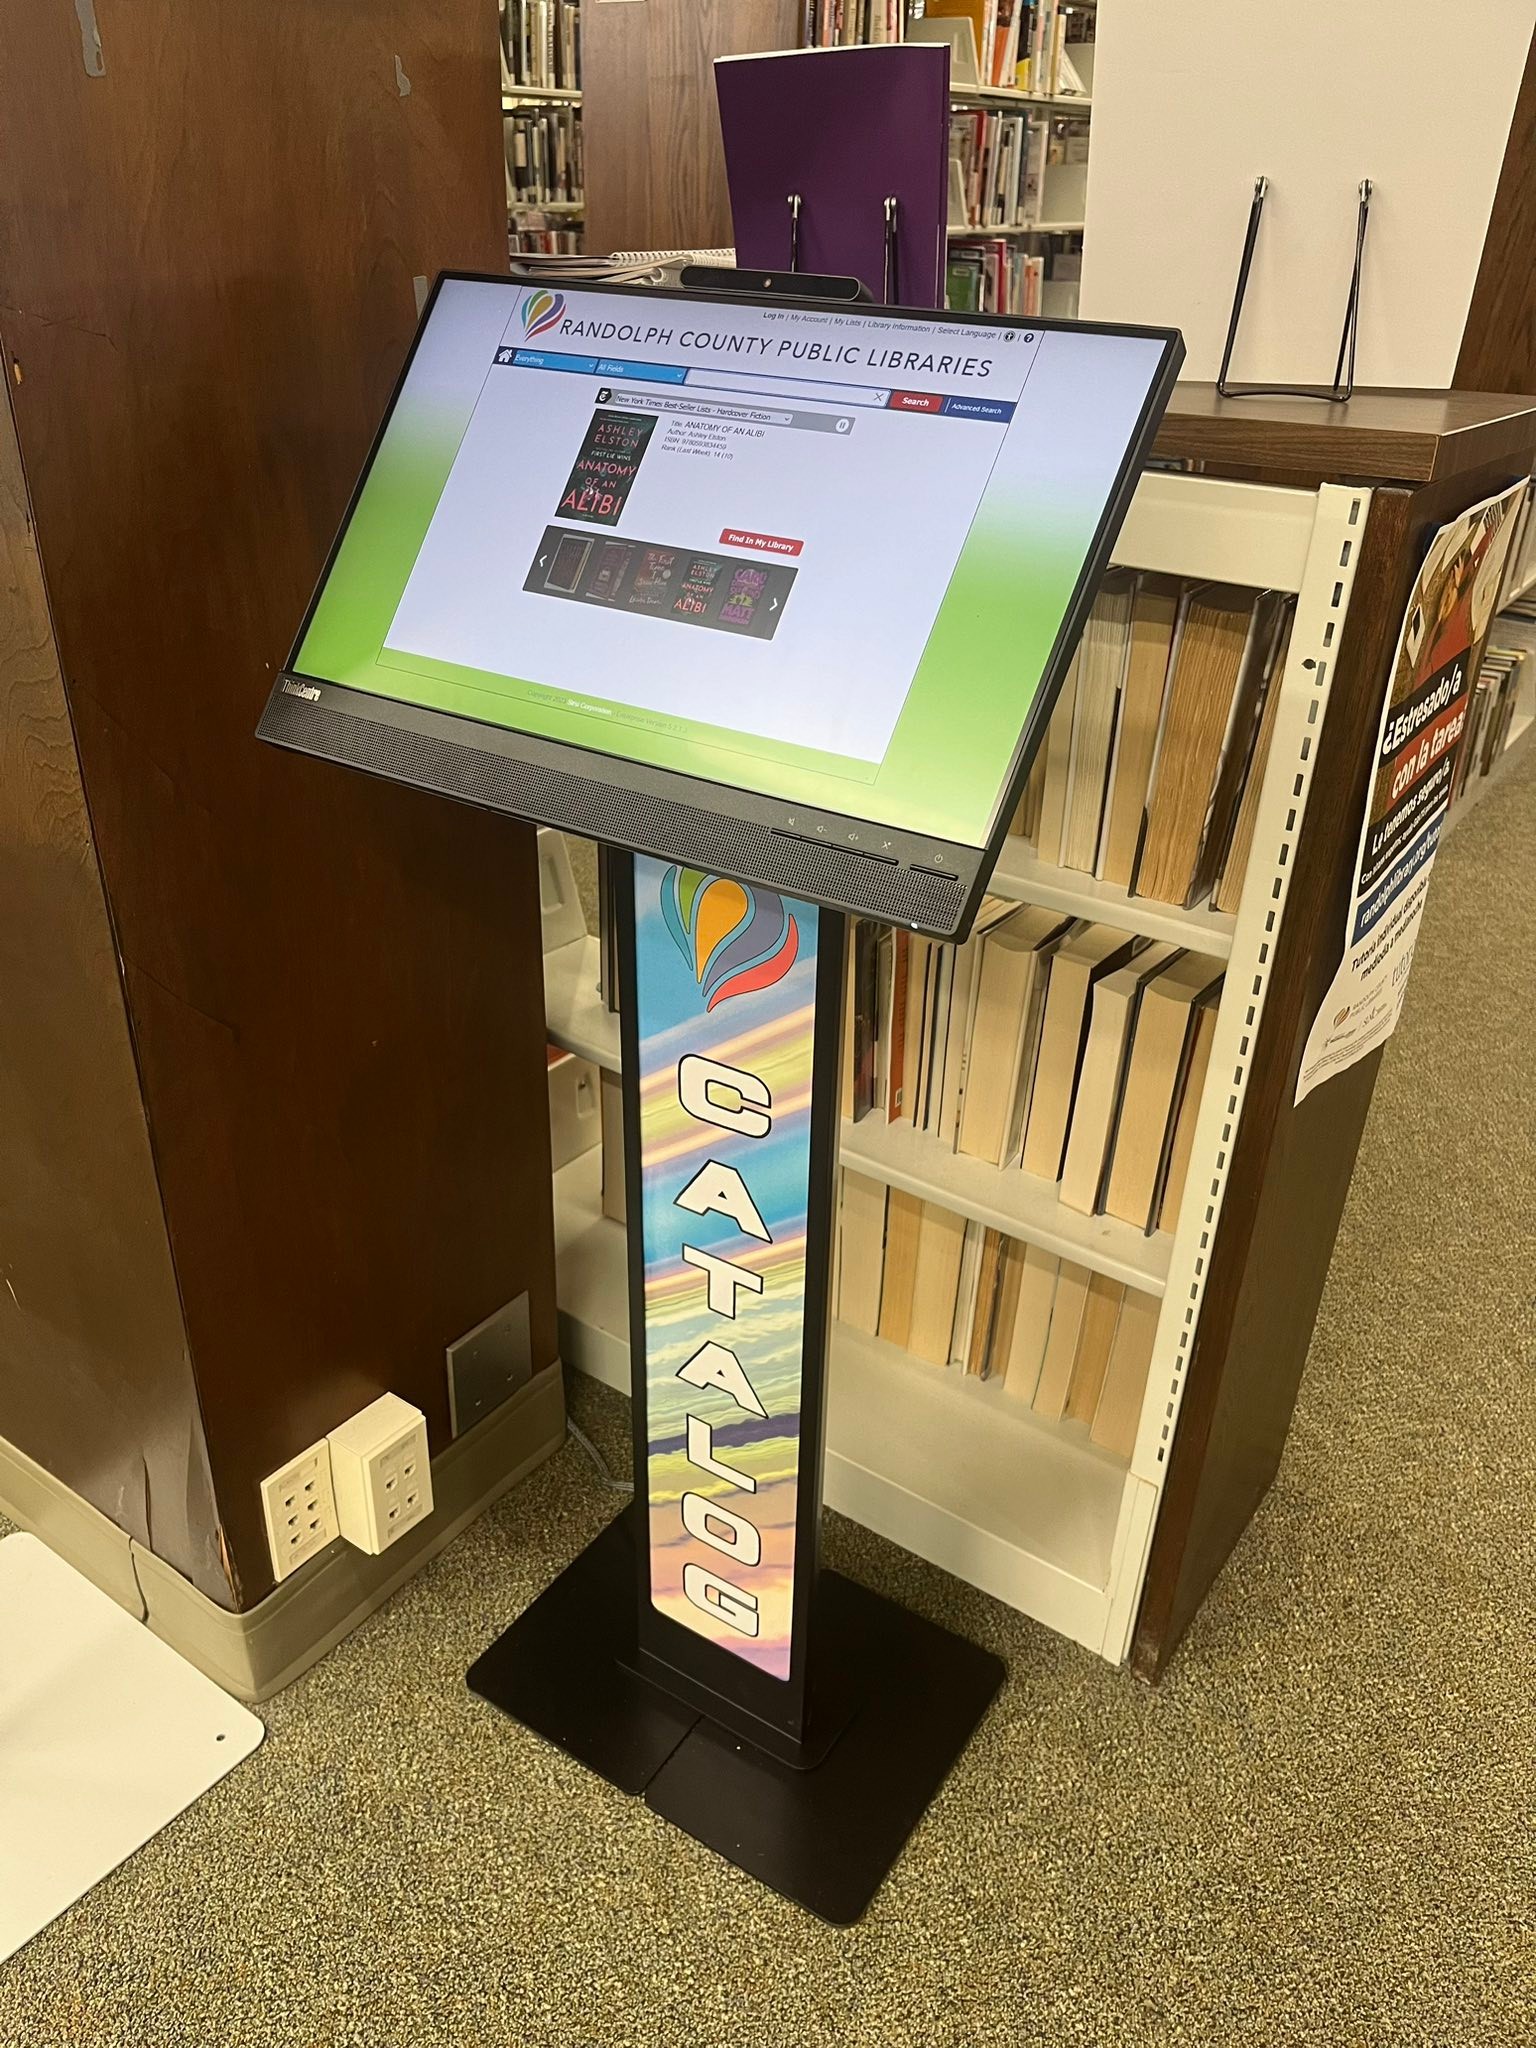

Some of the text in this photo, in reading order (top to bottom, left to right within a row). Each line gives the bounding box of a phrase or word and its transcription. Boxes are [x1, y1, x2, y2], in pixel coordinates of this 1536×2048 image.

[763, 311, 777, 320] Log
[791, 314, 828, 325] My Account
[834, 318, 861, 327] My Lists
[868, 321, 931, 334] Library Information
[938, 326, 996, 340] Select Language
[559, 318, 993, 378] RANDOLPH COUNTY PUBLIC LIBRARIES
[514, 353, 545, 365] Everything
[598, 363, 624, 373] All Fields
[616, 395, 630, 404] New
[630, 396, 645, 405] York
[646, 398, 663, 407] Times
[664, 400, 696, 411] Best-Seller
[697, 404, 711, 414] Lists
[717, 408, 749, 418] Hardcover
[750, 411, 771, 421] Fiction
[902, 396, 930, 408] Search
[951, 402, 1002, 415] Advanced Search
[598, 424, 643, 437] ASHLEY
[684, 421, 721, 432] ANATOMY
[722, 425, 733, 433] OF
[733, 427, 747, 435] AN
[747, 428, 765, 438] ALIBI
[595, 434, 639, 448] ELSTON
[577, 459, 637, 477] ANATOMY
[585, 477, 617, 488] OF AN
[561, 489, 622, 516] ALIBI
[728, 533, 794, 553] Find In My Library
[673, 598, 707, 614] ALIBI
[1382, 663, 1462, 755] ¿Estresado/a
[1392, 754, 1416, 799] con
[1416, 738, 1430, 774] la
[673, 1053, 773, 1637] CATALOG
